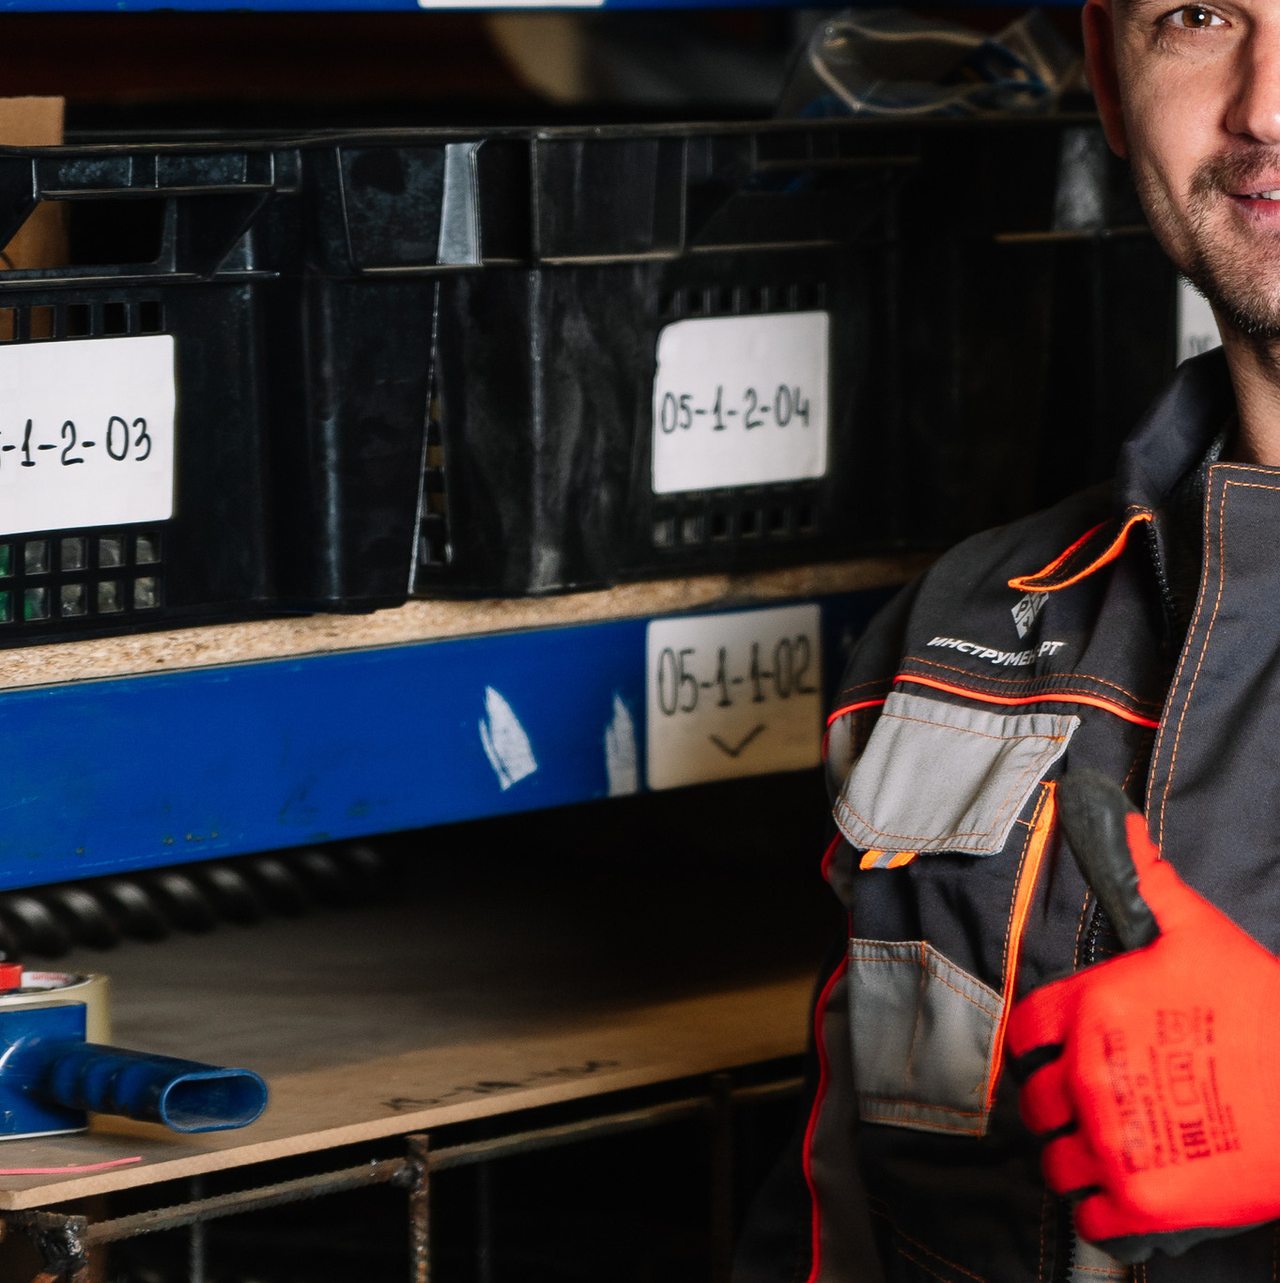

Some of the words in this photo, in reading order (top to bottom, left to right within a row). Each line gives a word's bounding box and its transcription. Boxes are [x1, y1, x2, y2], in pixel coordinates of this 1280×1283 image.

[660, 384, 813, 435] 05-1-2-04
[657, 631, 816, 716] 05-1-1-02
[926, 636, 1066, 667] ИНСТРУМЕН-РТ
